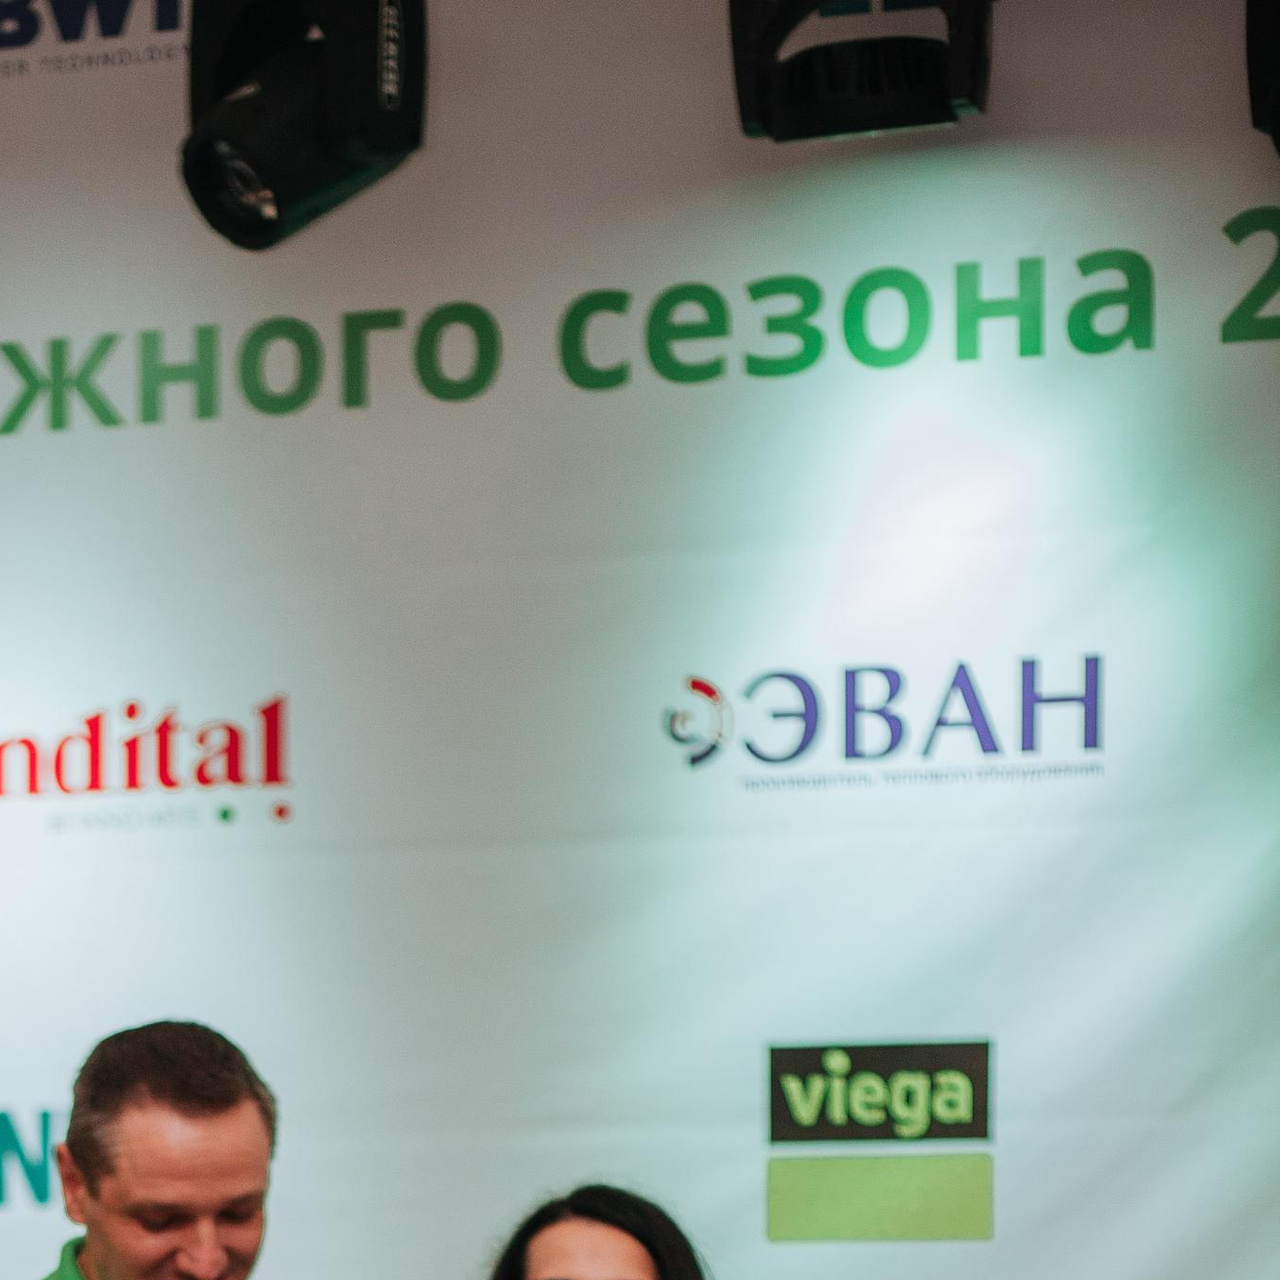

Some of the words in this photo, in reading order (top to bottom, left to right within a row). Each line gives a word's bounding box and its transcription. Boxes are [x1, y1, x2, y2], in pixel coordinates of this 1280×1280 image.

[557, 247, 1156, 391] сезона
[743, 655, 1106, 764] ЭВАН
[779, 1049, 975, 1138] viega
